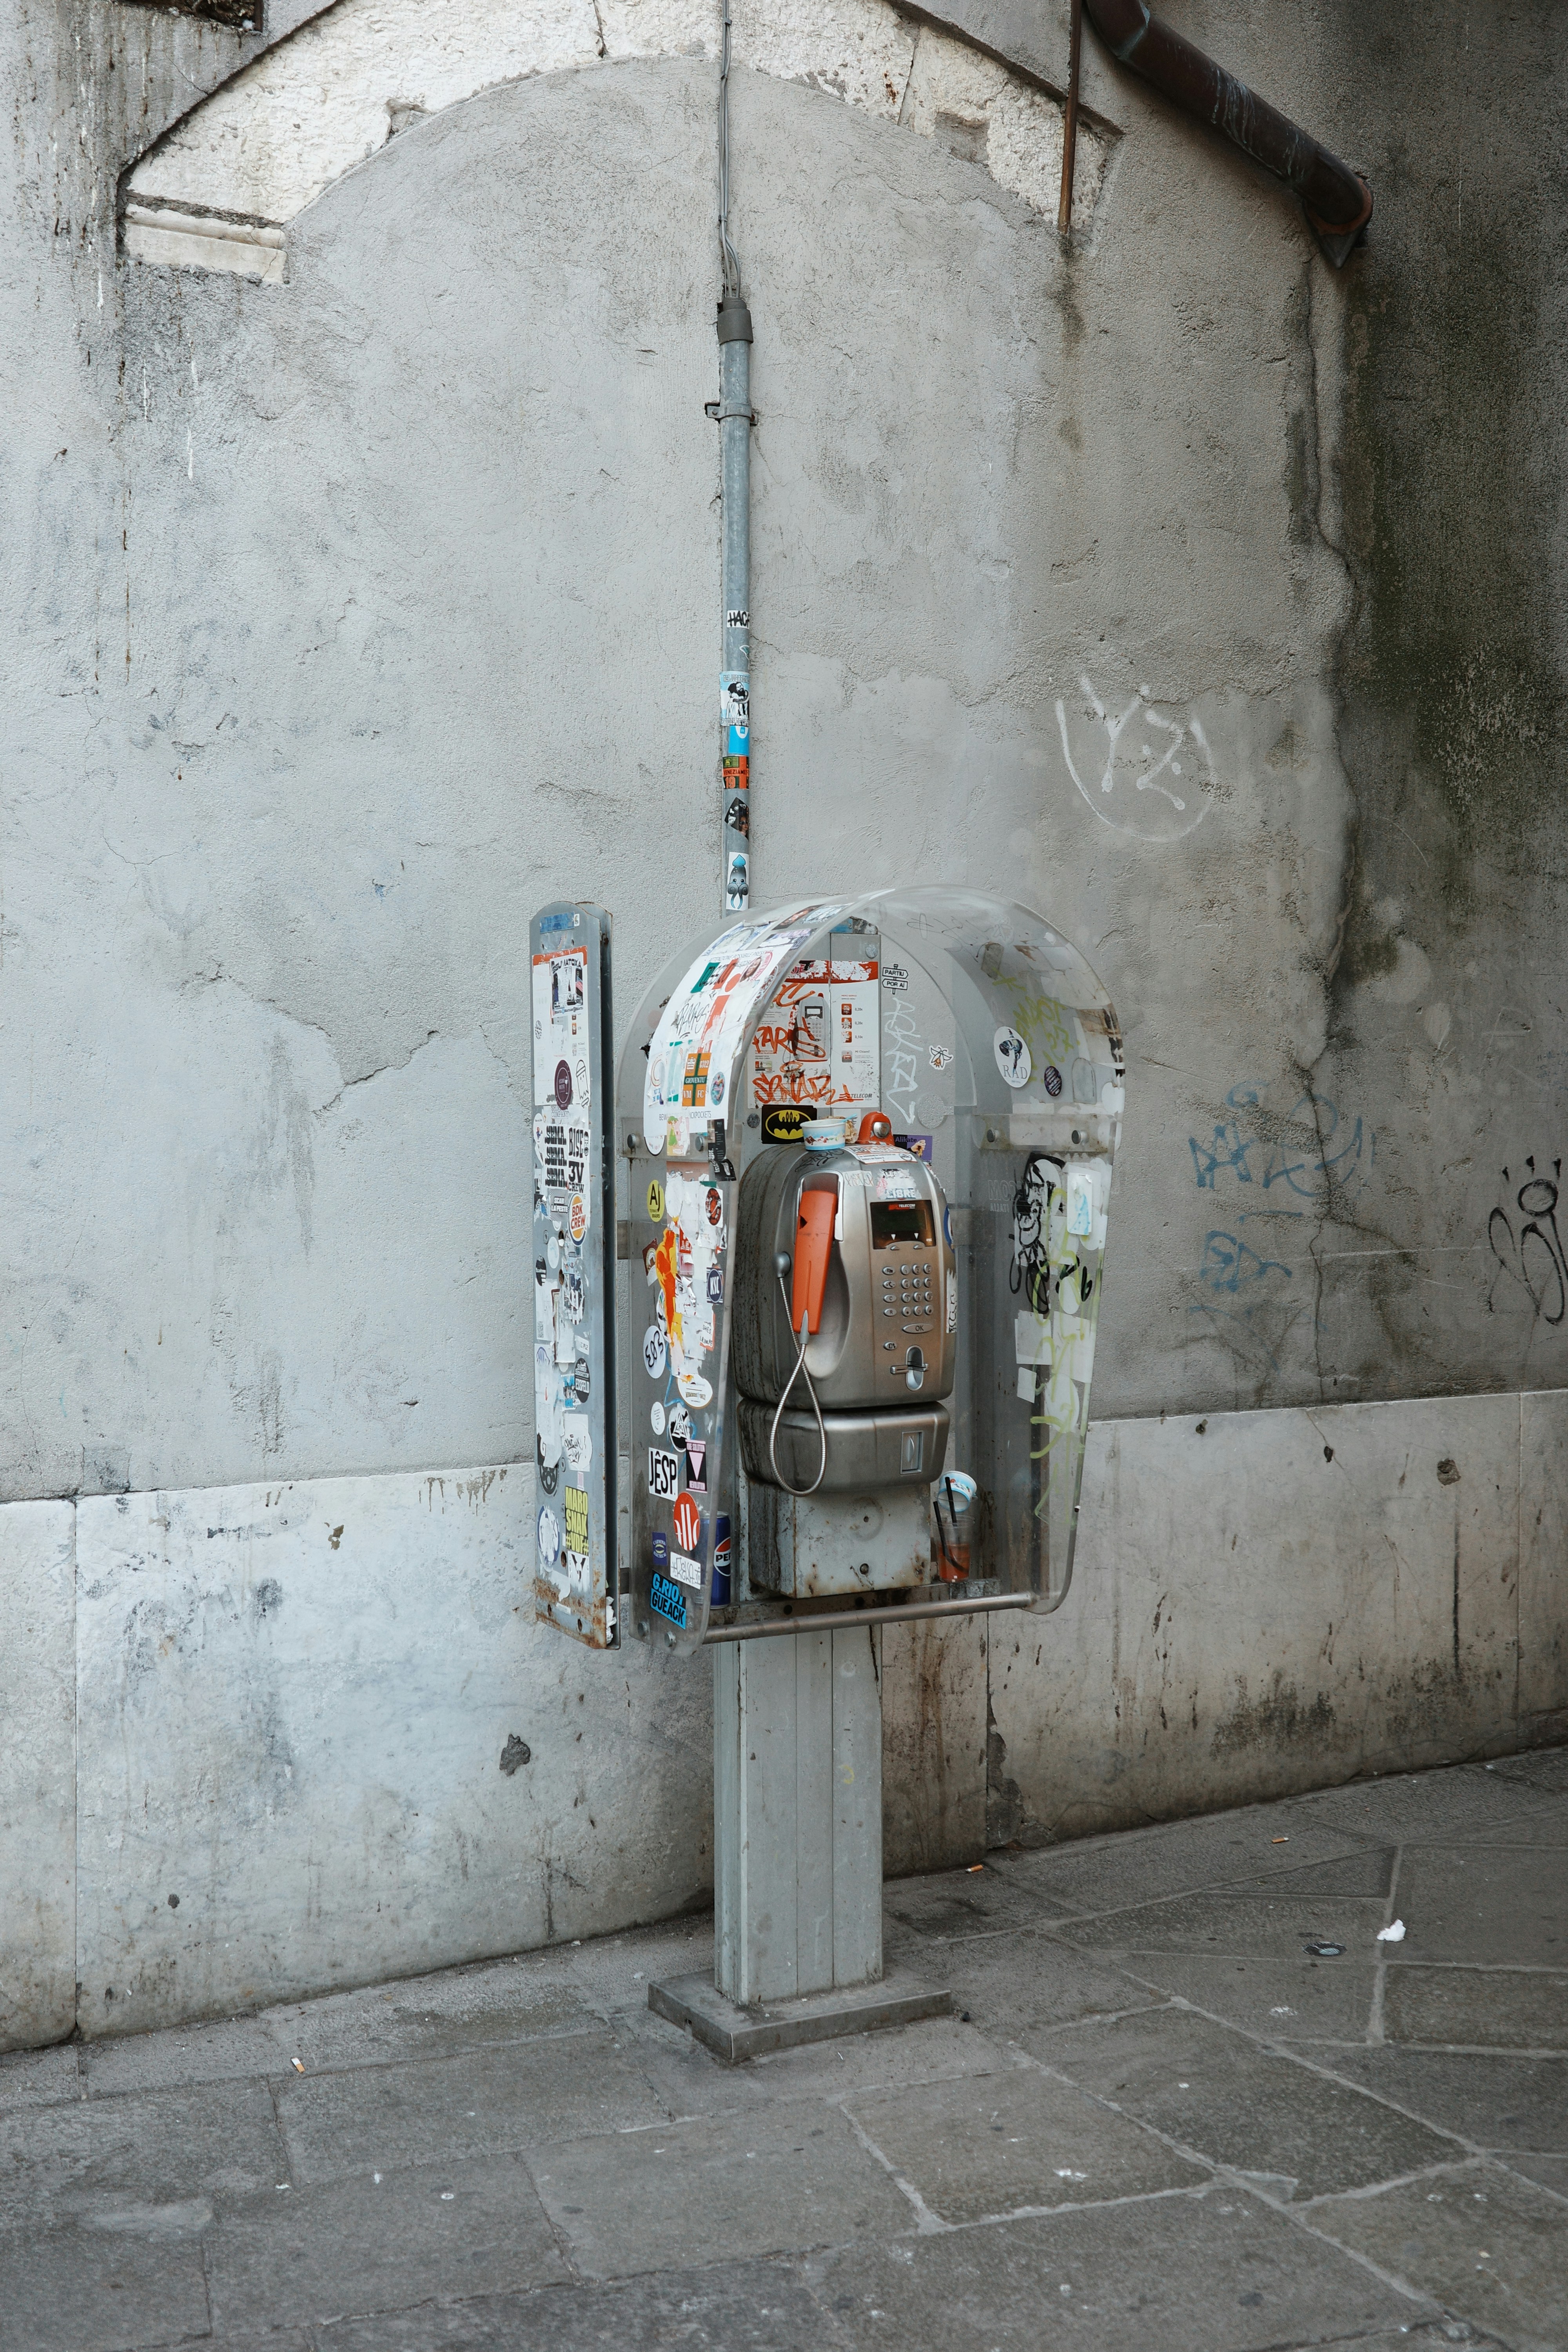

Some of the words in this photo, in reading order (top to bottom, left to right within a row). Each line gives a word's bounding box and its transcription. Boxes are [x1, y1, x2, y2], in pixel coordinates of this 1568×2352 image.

[725, 776, 735, 789] 19
[1002, 1064, 1028, 1079] RAD
[683, 1089, 691, 1098] VM
[697, 1090, 704, 1098] FC
[568, 1182, 584, 1194] CREW
[572, 1203, 583, 1217] BDK
[571, 1214, 586, 1230] CREW
[565, 1486, 588, 1516] MARO
[566, 1509, 588, 1537] SNAK
[566, 1532, 589, 1557] #VDF#
[652, 1592, 685, 1626] GUEACK
